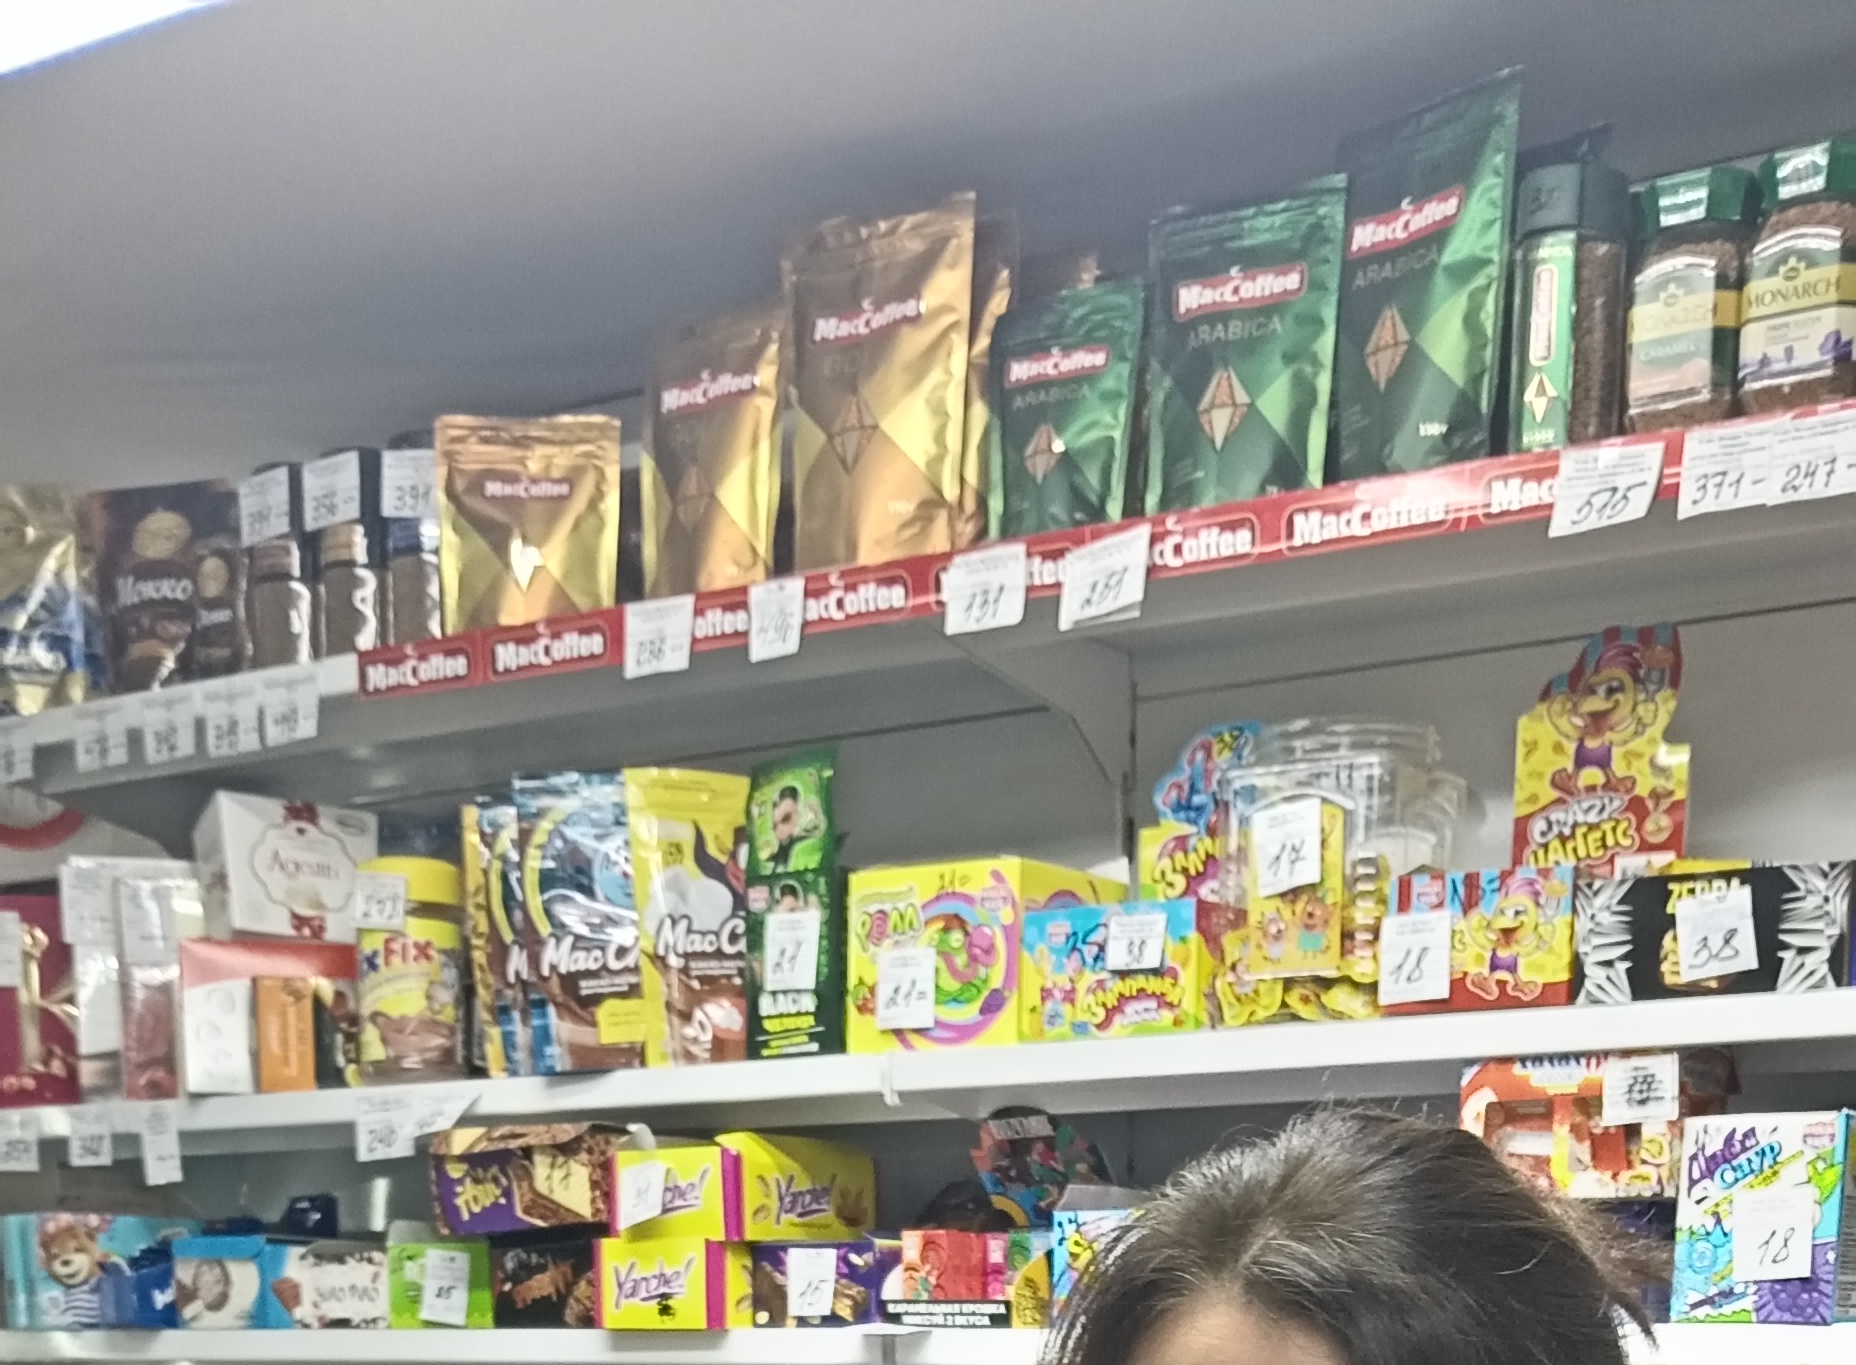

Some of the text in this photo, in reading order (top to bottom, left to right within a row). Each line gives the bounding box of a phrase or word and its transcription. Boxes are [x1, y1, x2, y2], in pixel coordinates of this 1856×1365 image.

[1350, 192, 1460, 252] MacCoffee
[1178, 267, 1301, 314] MacCoffee
[813, 299, 927, 341] MacCoffee
[1009, 348, 1107, 382] MacCoffee
[1291, 497, 1449, 547] MacCoffee
[1153, 525, 1253, 568] cCoffee
[805, 583, 906, 622] acCoffee
[694, 608, 748, 640] offee
[365, 653, 469, 692] MacCoffee
[494, 630, 605, 673] MacCoffee
[1533, 796, 1625, 843] CRAZY
[1757, 1226, 1795, 1267] 18
